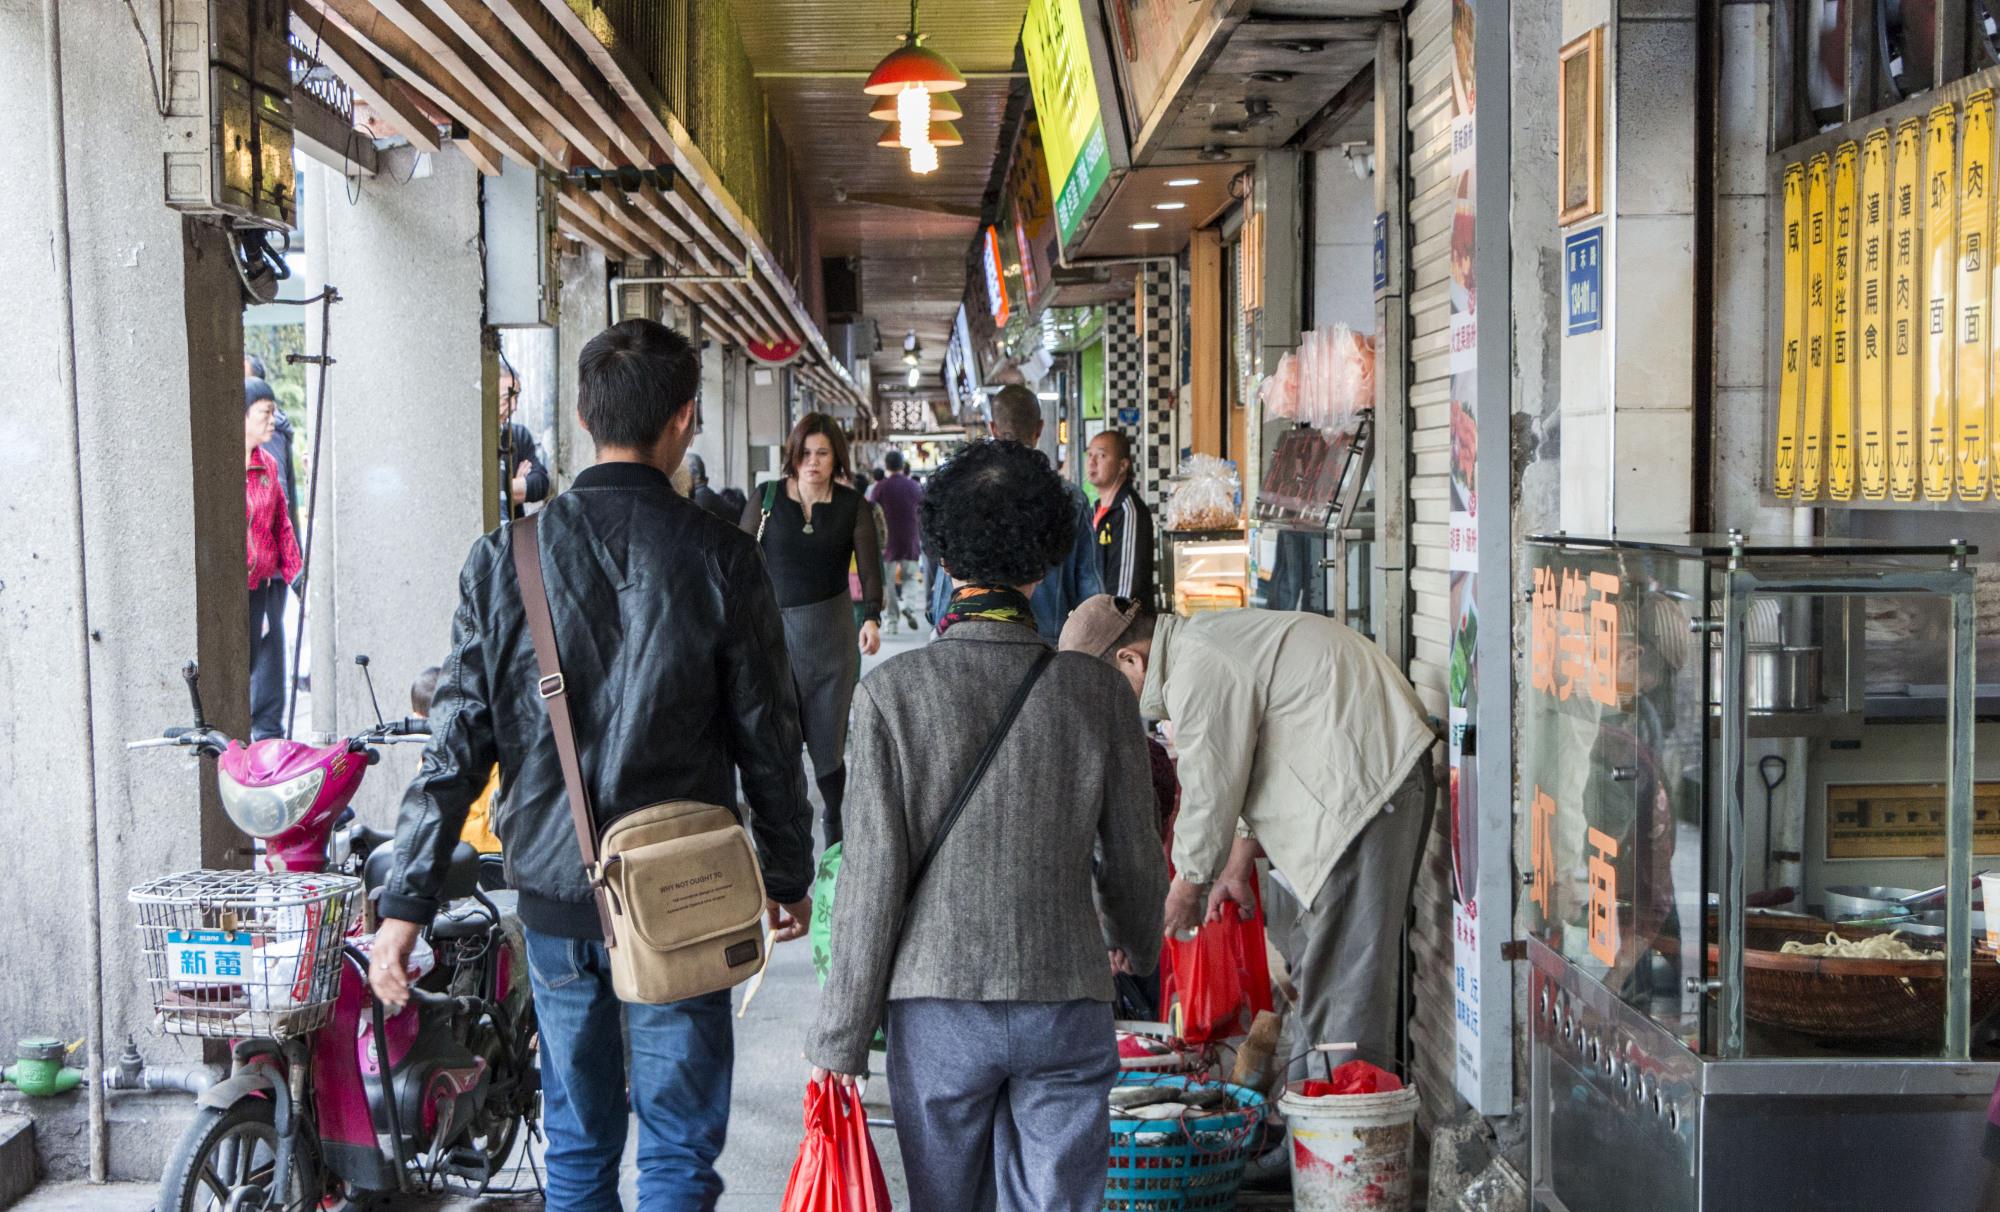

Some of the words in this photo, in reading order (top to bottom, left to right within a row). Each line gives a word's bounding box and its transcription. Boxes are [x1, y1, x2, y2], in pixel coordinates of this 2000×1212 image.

[1896, 183, 1911, 356] 漳浦肉圆
[1930, 170, 1947, 335] 虾面
[1965, 160, 1984, 344] 肉圆面
[1787, 219, 1799, 373] 咸饭
[1811, 211, 1823, 368] 面线糊
[1865, 191, 1880, 360] 漳浦扁食
[1780, 436, 1792, 469] 元
[1804, 435, 1817, 469] 元
[1835, 434, 1847, 469] 元
[1865, 431, 1879, 468] 元
[1896, 430, 1909, 468] 元
[1929, 427, 1944, 466] 元
[1963, 424, 1980, 465] 元
[1531, 565, 1620, 706] 酸笋面
[676, 880, 689, 889] NOT
[689, 873, 713, 886] OUGHT
[1529, 784, 1617, 967] 虾面
[181, 949, 241, 976] 新蕾
